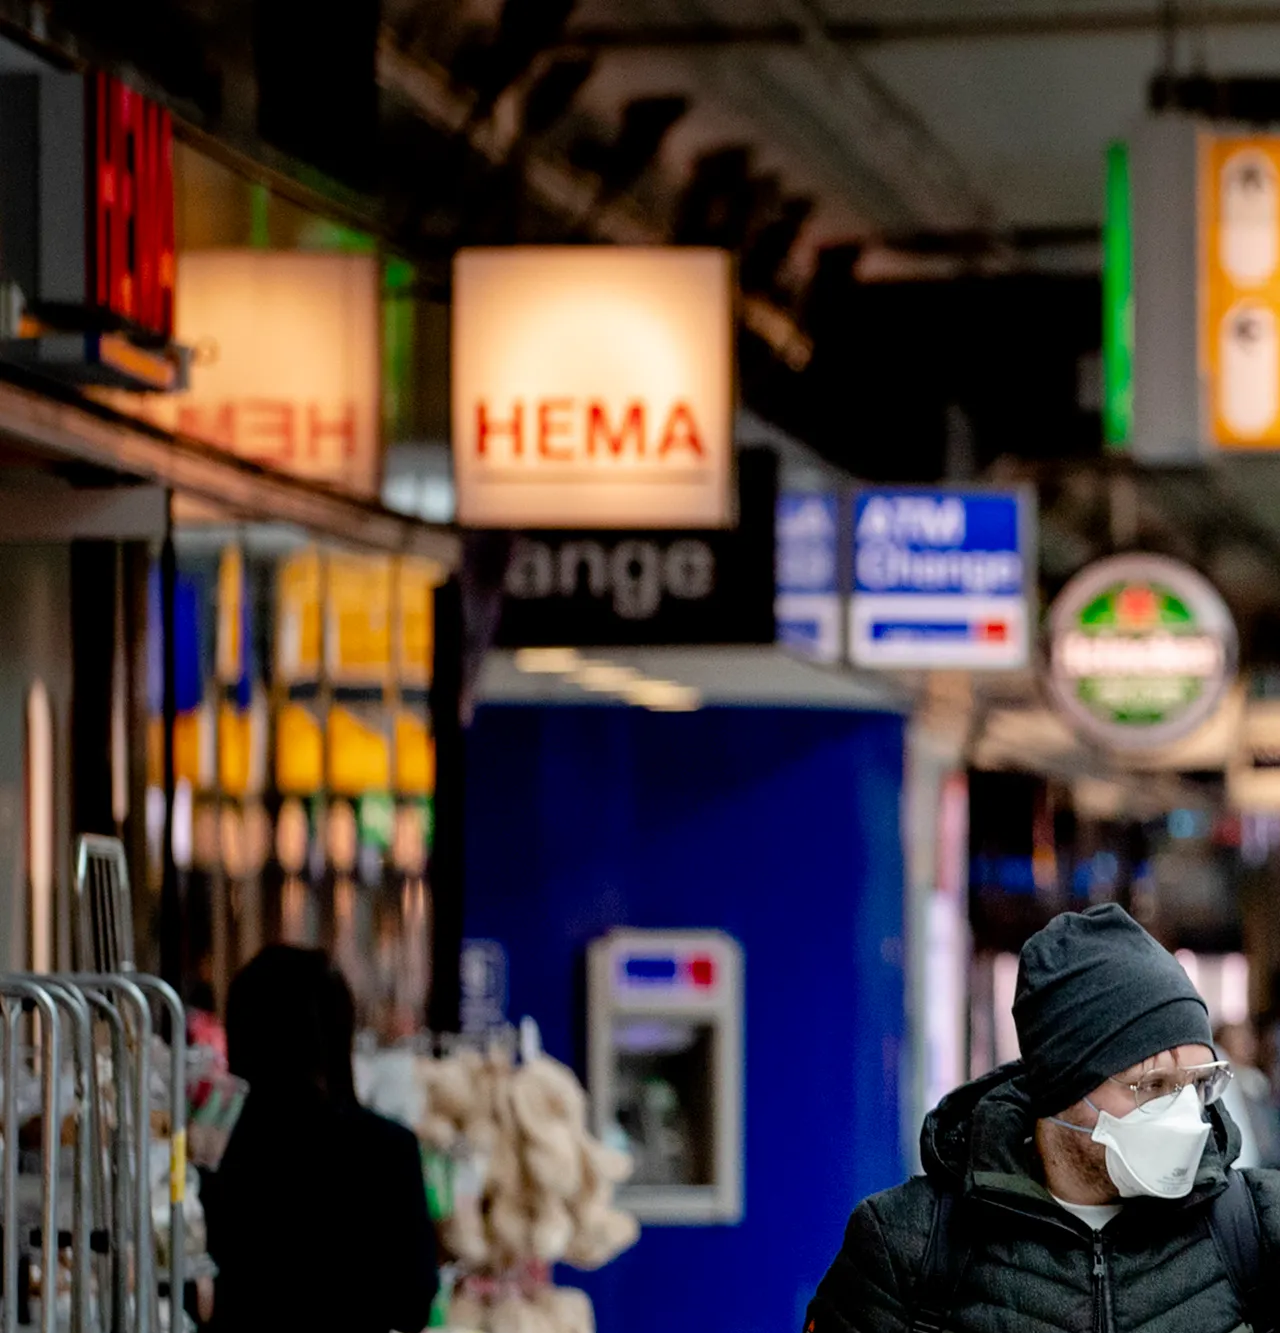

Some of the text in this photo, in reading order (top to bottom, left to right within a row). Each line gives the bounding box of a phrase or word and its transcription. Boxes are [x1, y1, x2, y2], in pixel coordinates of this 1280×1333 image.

[475, 398, 708, 461] HEMA
[857, 499, 966, 547] ATM
[505, 540, 714, 620] ange
[856, 543, 1022, 593] Change
